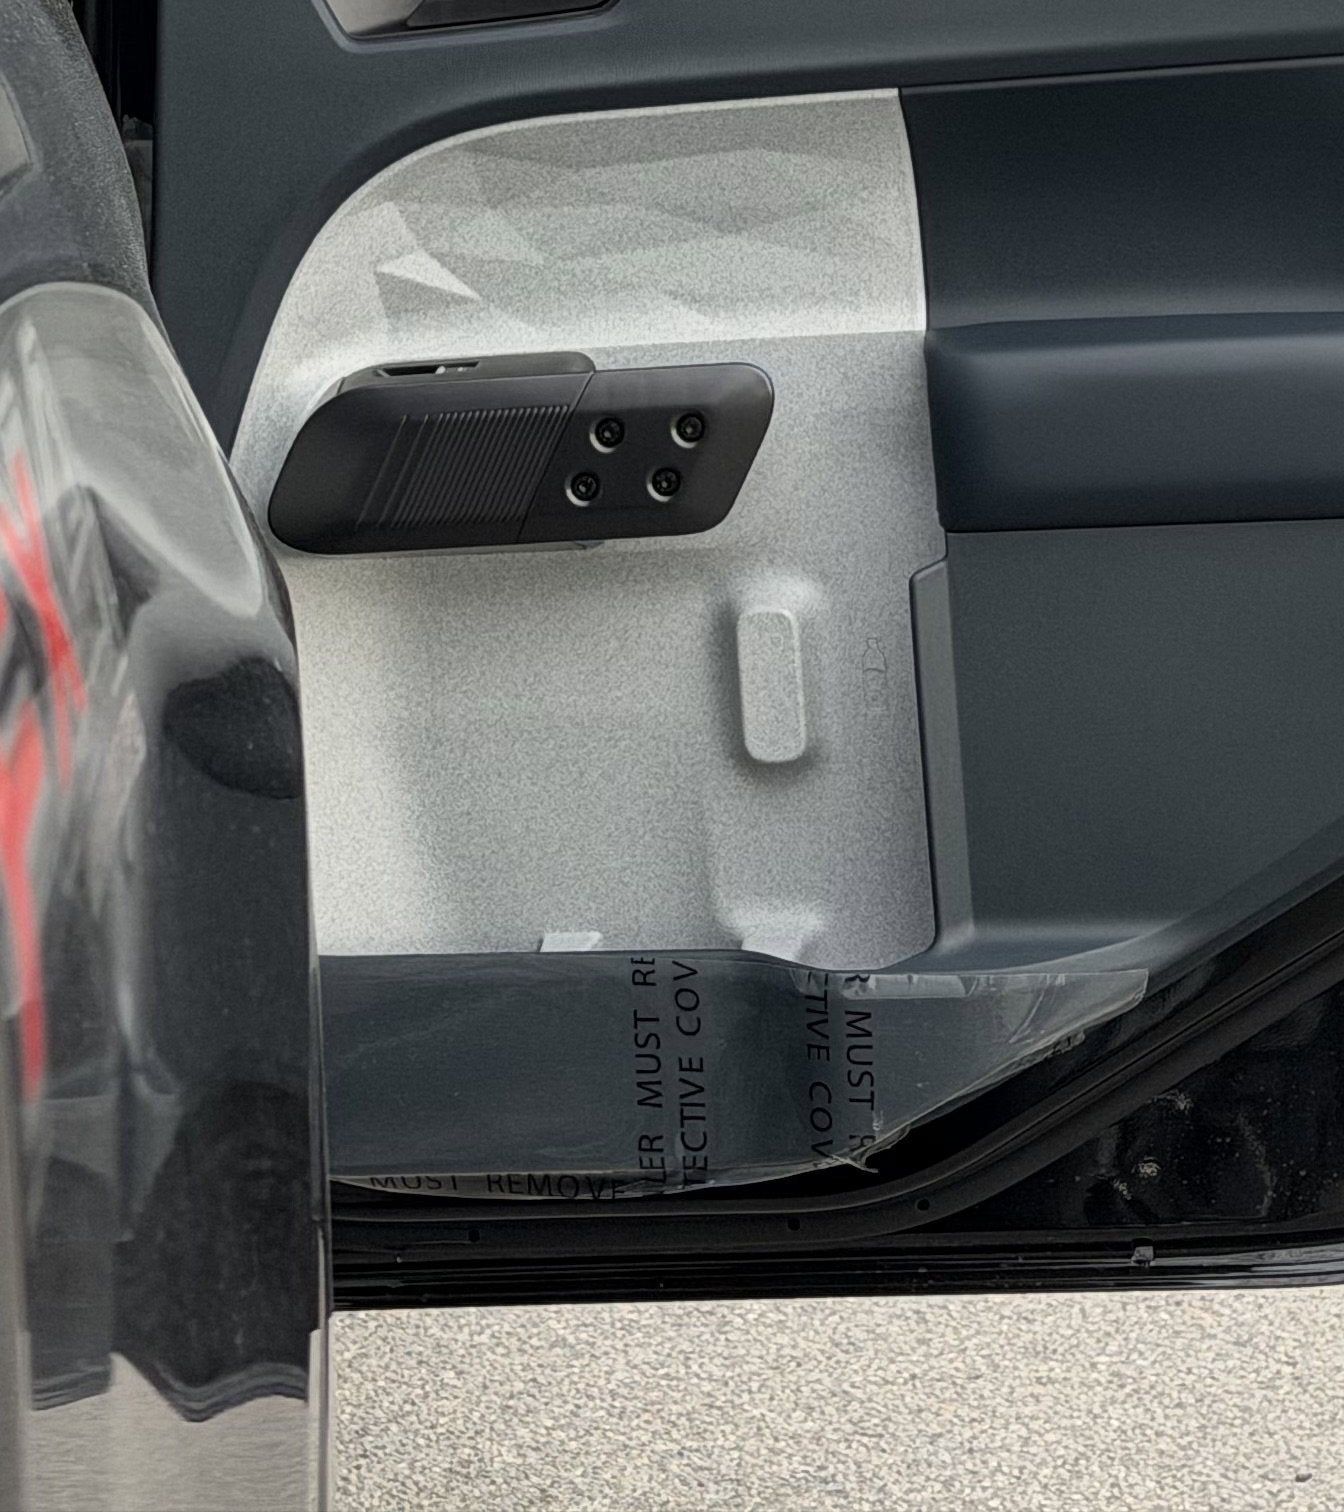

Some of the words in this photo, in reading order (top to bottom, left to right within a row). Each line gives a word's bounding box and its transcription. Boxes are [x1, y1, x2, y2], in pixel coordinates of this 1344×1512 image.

[672, 961, 702, 1037] COV
[633, 1009, 664, 1108] MUST
[845, 1010, 875, 1111] MUST
